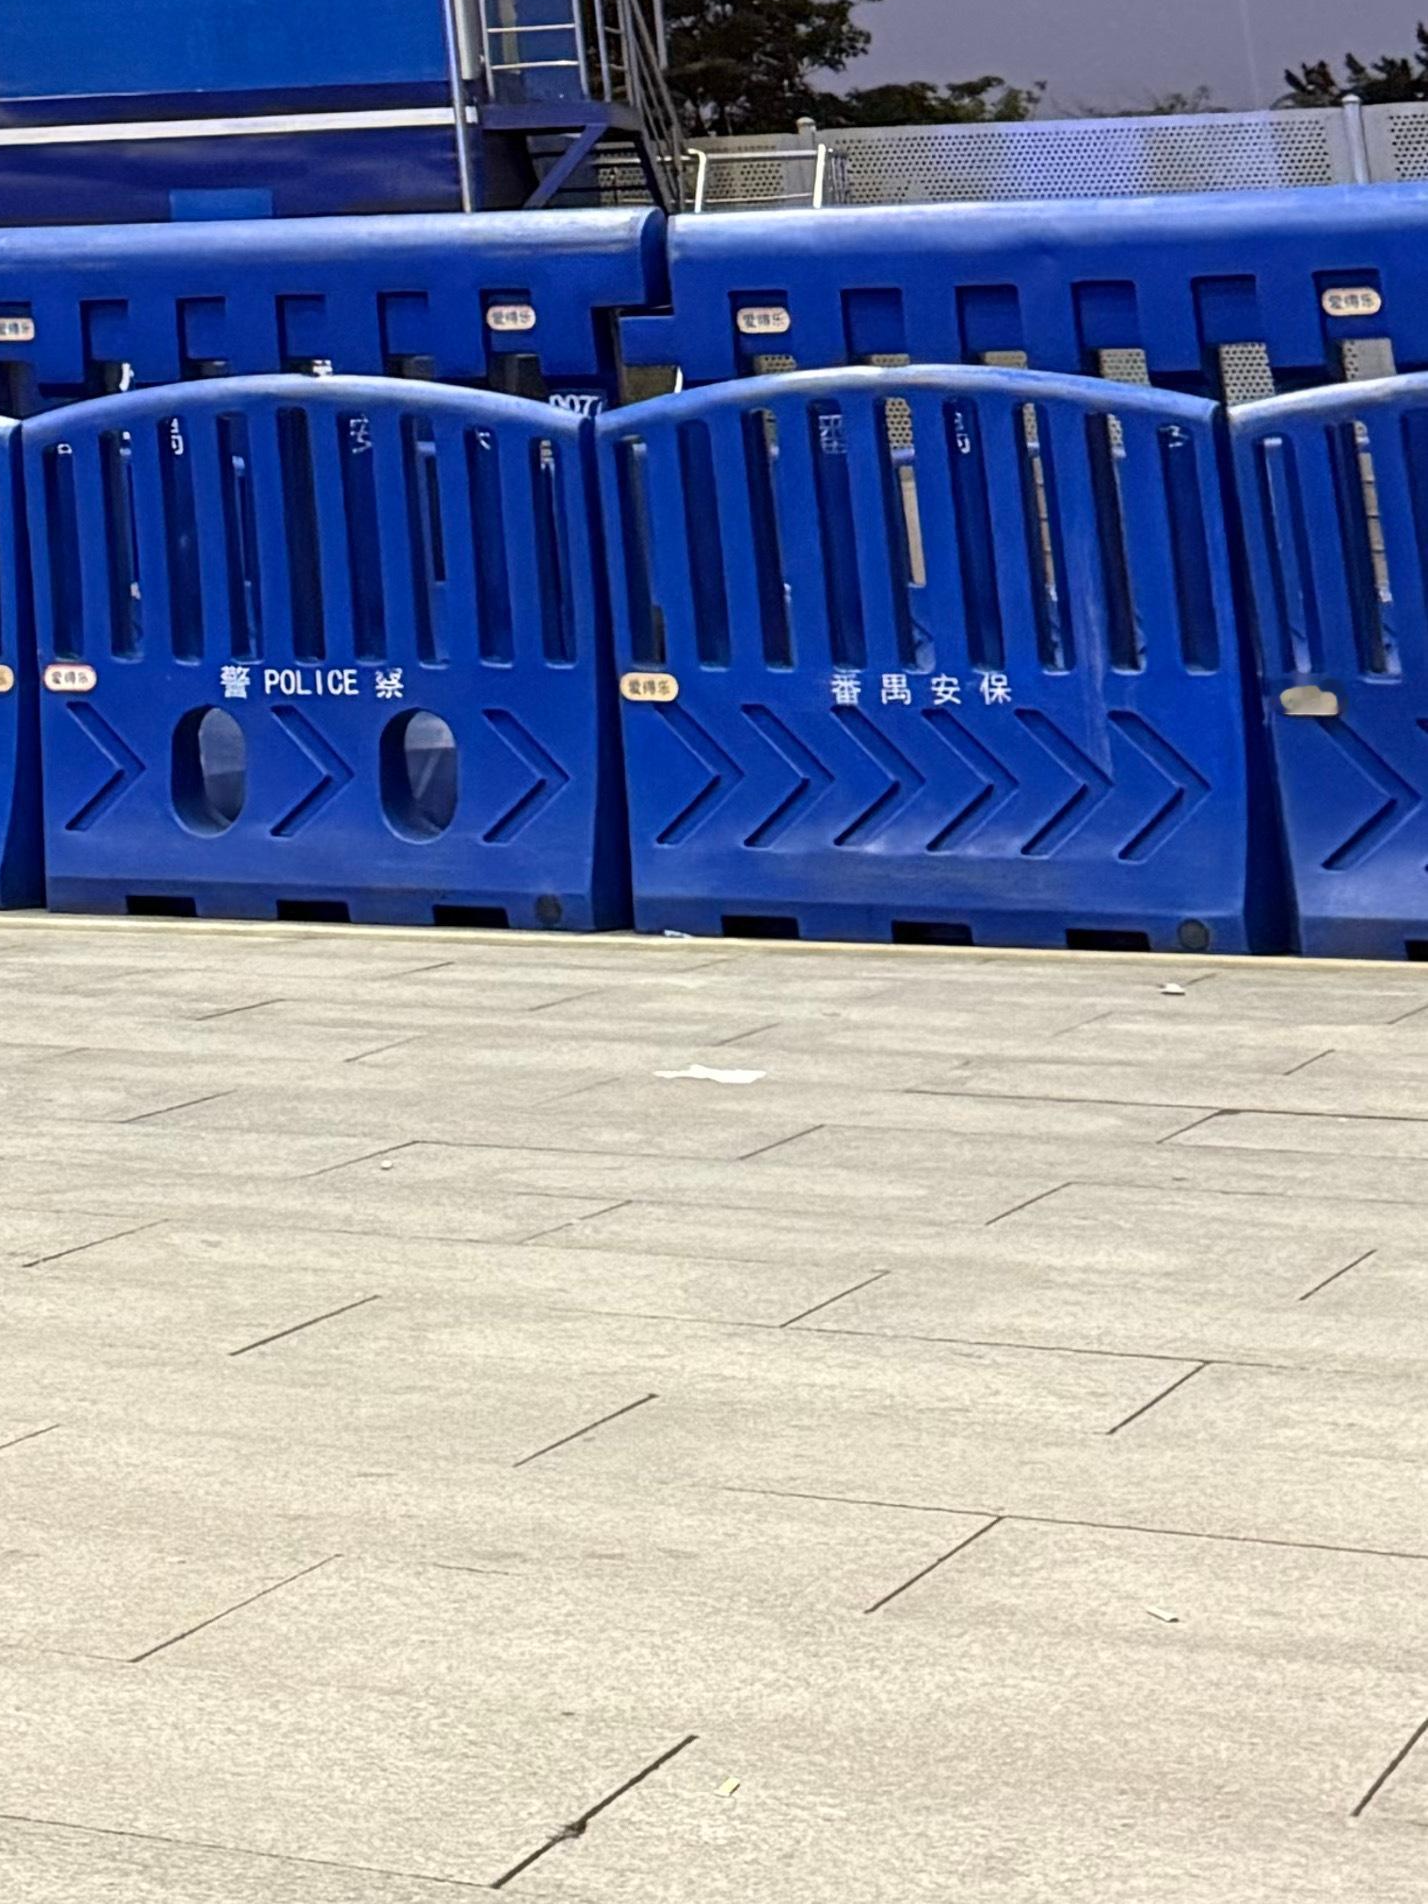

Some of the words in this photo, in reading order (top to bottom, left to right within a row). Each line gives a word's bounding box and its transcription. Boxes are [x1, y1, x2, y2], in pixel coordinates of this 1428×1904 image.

[219, 665, 251, 699] 警
[264, 668, 360, 696] POLICE
[375, 666, 405, 699] 察
[830, 672, 1012, 706] 番禺安保
